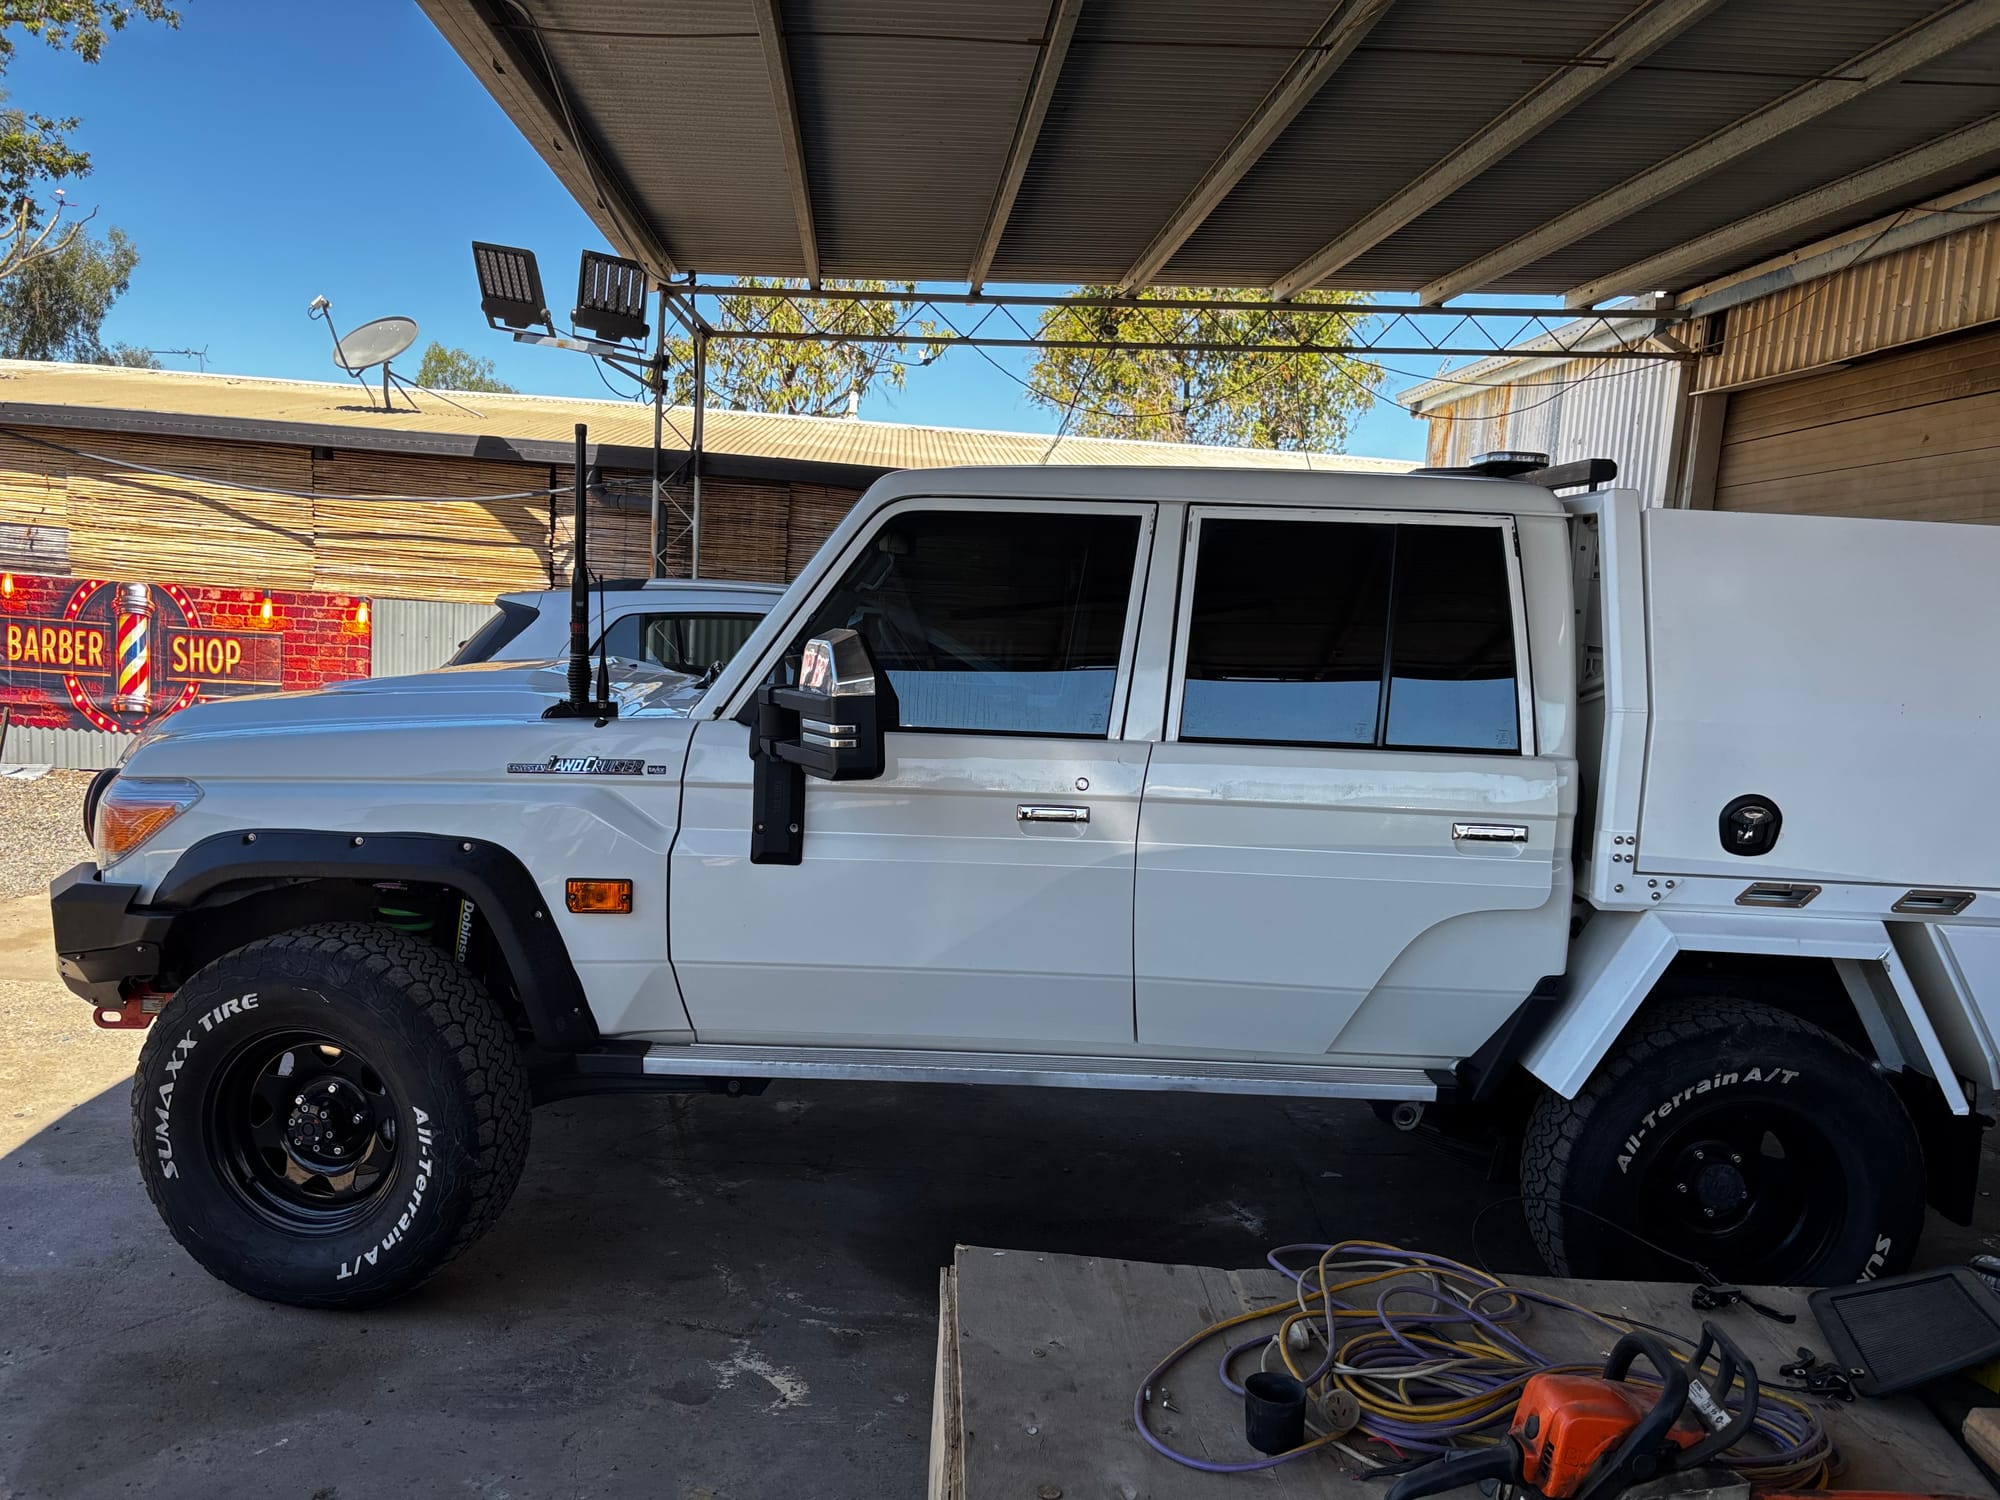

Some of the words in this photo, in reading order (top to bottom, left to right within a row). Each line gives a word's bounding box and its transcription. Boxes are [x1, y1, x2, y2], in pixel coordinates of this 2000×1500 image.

[6, 624, 104, 667] BARBER
[172, 636, 242, 675] SHOP
[457, 899, 475, 963] Dobinso
[155, 1029, 198, 1180] SUMAXX
[197, 992, 260, 1032] TIRE
[1616, 1072, 1739, 1174] All-Terrain
[1742, 1067, 1801, 1086] A/T
[381, 1106, 434, 1251] All-Terrain
[336, 1245, 379, 1280] A/T
